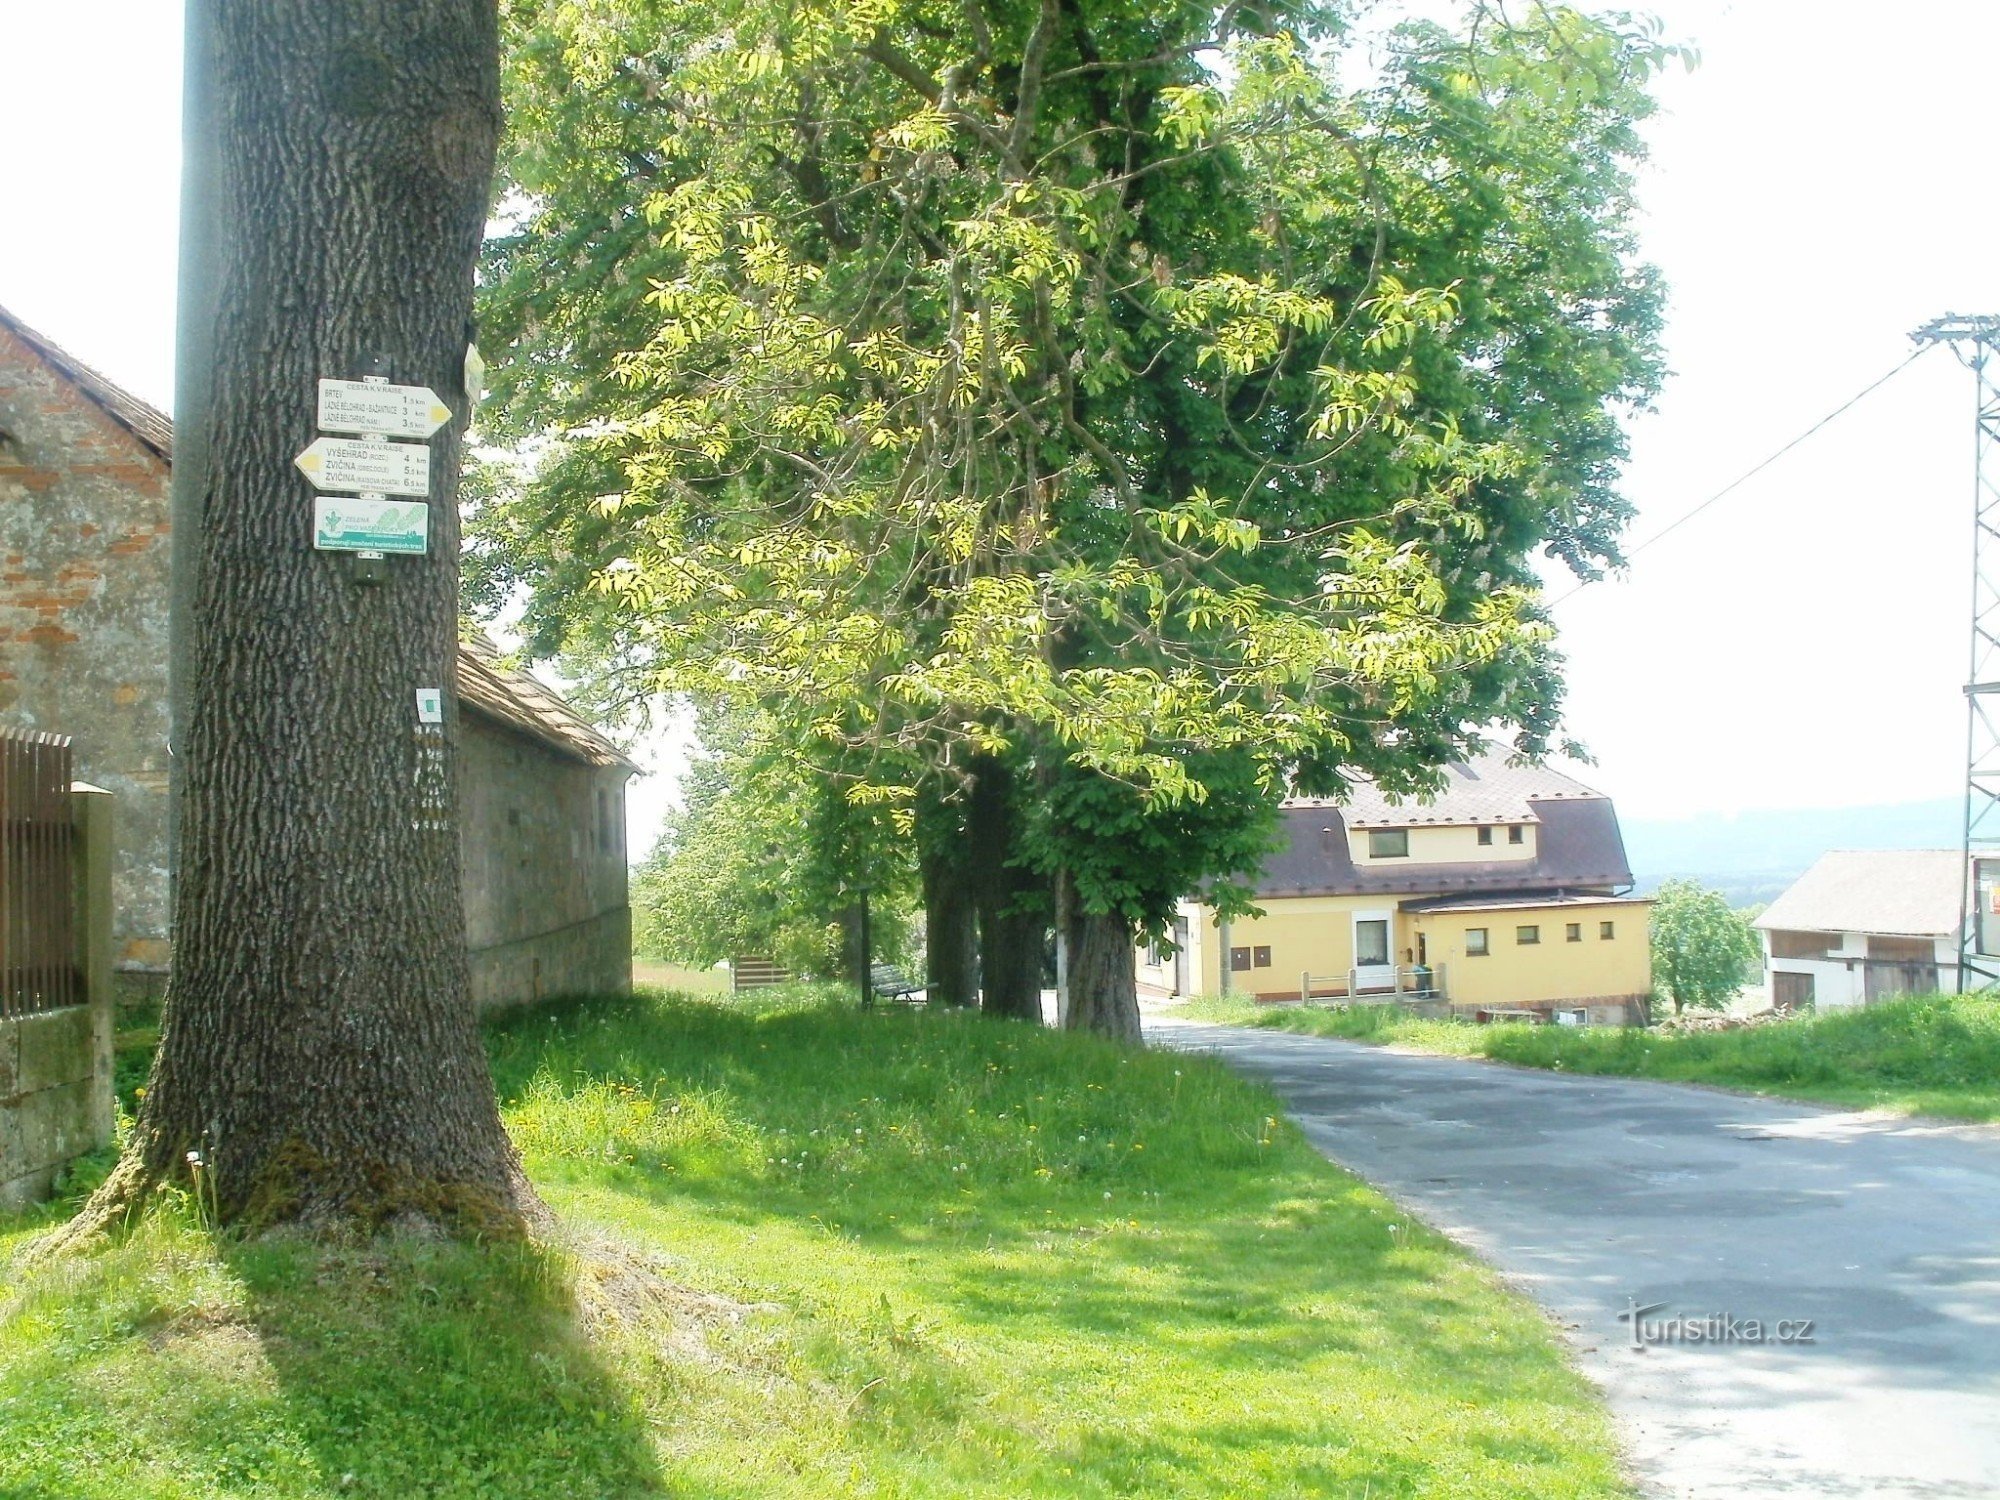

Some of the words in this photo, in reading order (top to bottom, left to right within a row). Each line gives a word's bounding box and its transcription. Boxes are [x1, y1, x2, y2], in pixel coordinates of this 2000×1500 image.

[346, 383, 369, 391] CESTA
[402, 407, 408, 416] 3
[347, 442, 370, 450] CESTA
[326, 446, 368, 460] VYŠEHRAD
[404, 454, 410, 462] 4
